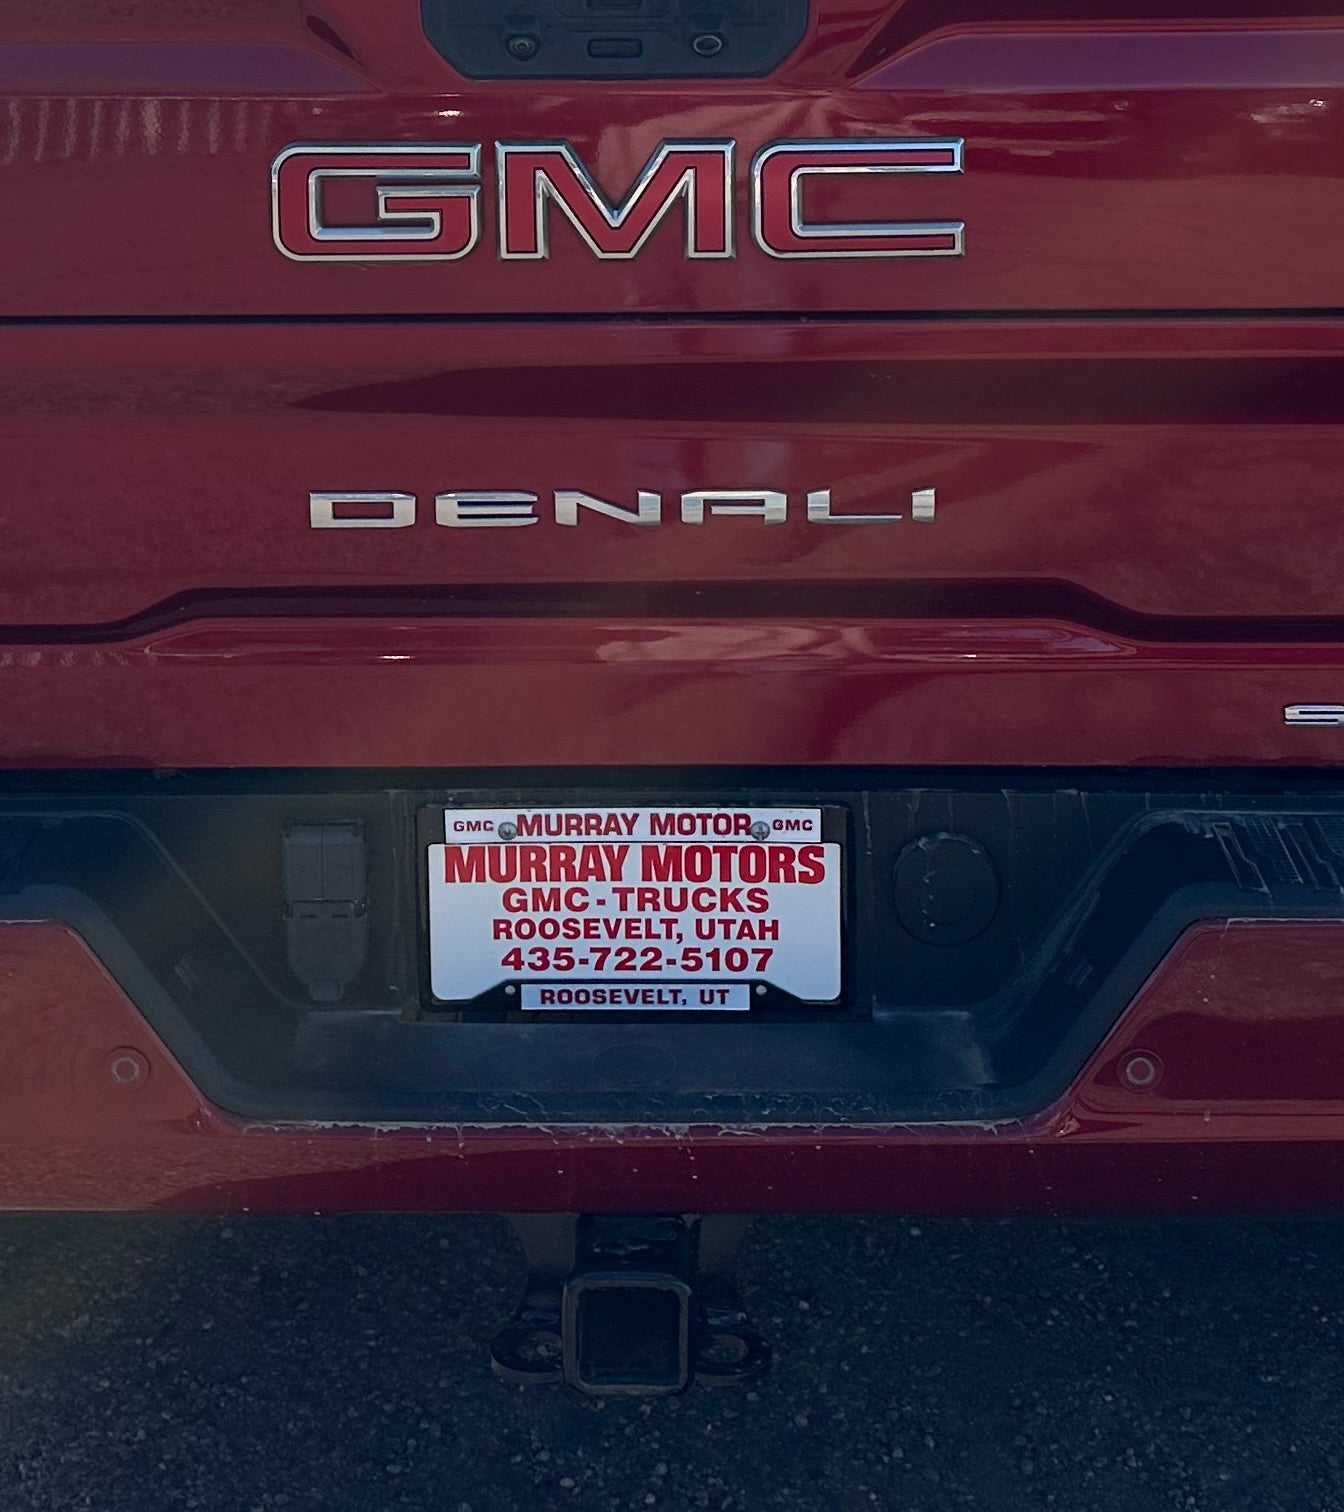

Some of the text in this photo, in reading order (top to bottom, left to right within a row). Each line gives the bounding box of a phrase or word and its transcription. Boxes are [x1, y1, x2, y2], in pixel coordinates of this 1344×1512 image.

[270, 137, 966, 264] GMC
[309, 487, 937, 529] DENALI
[453, 813, 814, 837] GMC MURRAY MOTOR GMC
[444, 844, 826, 885] MURRAY MOTORS
[492, 918, 780, 945] ROOSEVELT, UTAH
[501, 947, 774, 972] 435-722-5107
[539, 989, 731, 1007] ROOSEVELT, UT
